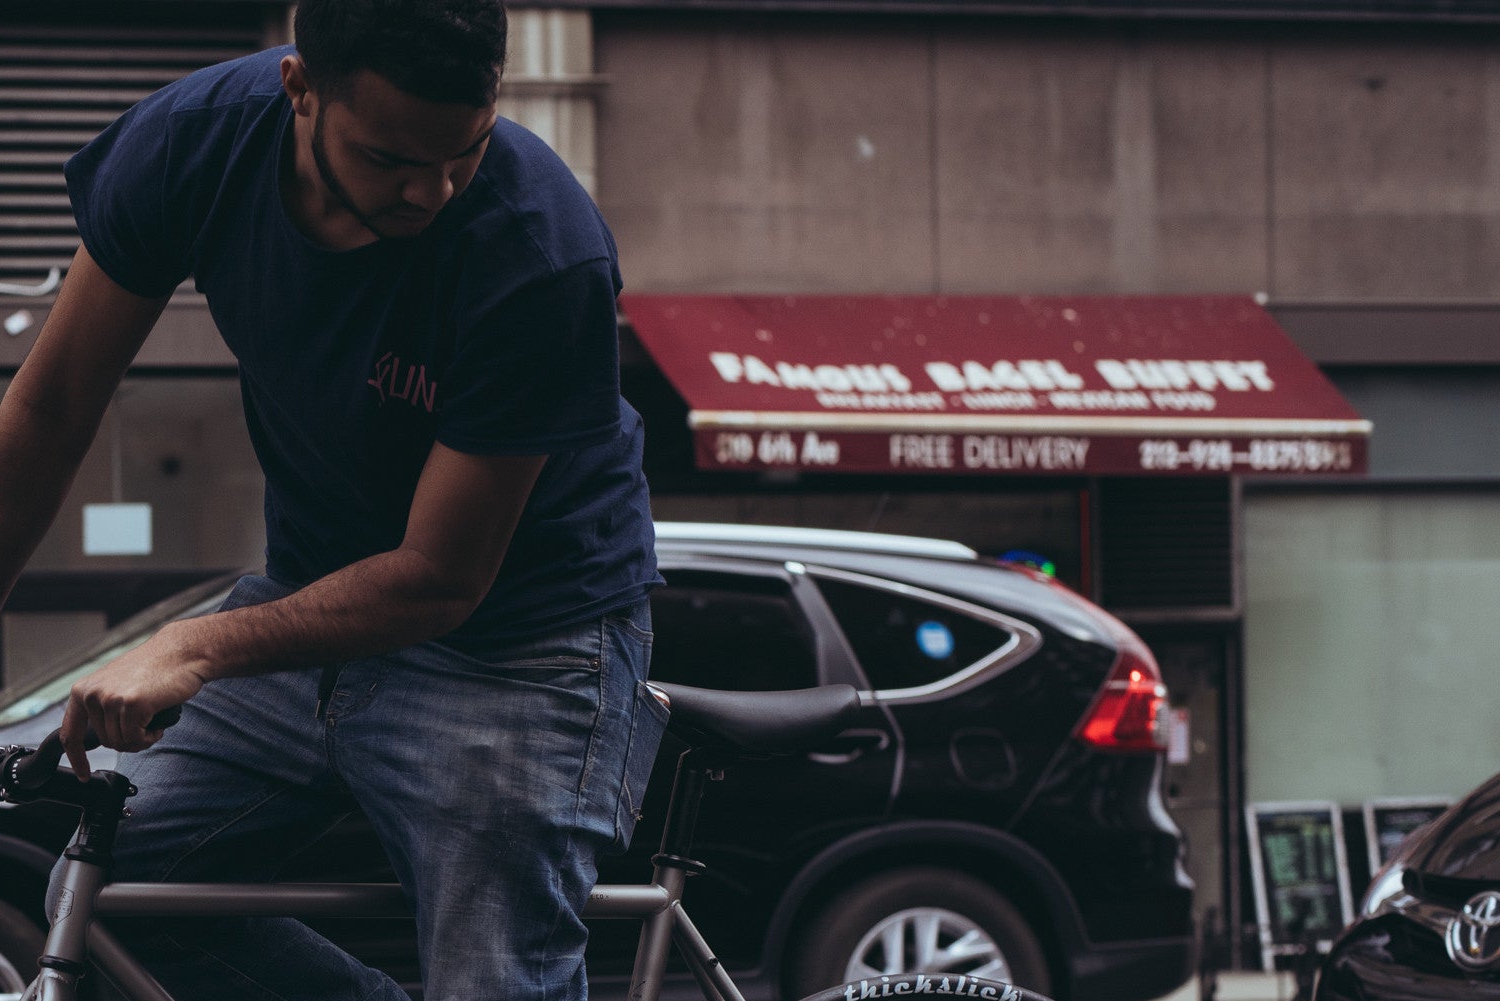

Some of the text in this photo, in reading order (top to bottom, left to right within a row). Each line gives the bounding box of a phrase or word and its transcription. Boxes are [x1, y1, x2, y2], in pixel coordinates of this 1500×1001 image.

[924, 360, 1084, 391] BAGEL
[890, 435, 1090, 469] FREE DELIVERY
